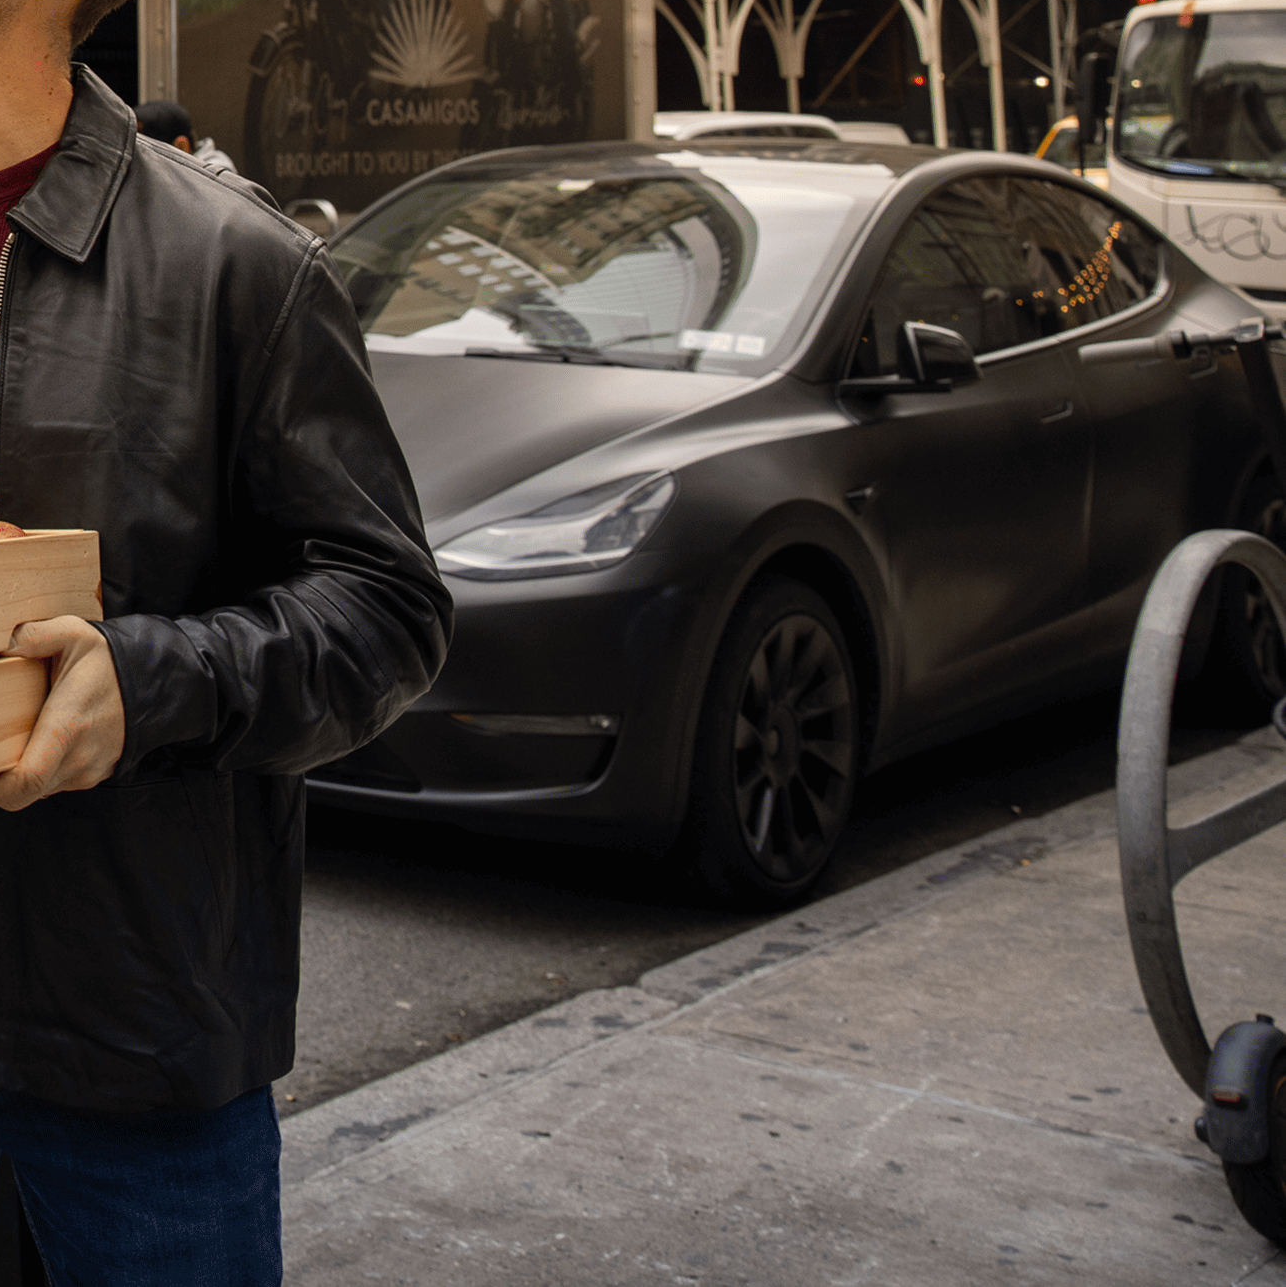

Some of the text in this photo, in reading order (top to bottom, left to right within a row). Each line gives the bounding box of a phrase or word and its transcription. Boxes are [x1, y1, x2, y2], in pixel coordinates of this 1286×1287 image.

[366, 98, 479, 127] CASAMIGOS
[275, 151, 351, 179] BROUGHT
[353, 150, 375, 175] TO
[377, 150, 410, 174] YOU
